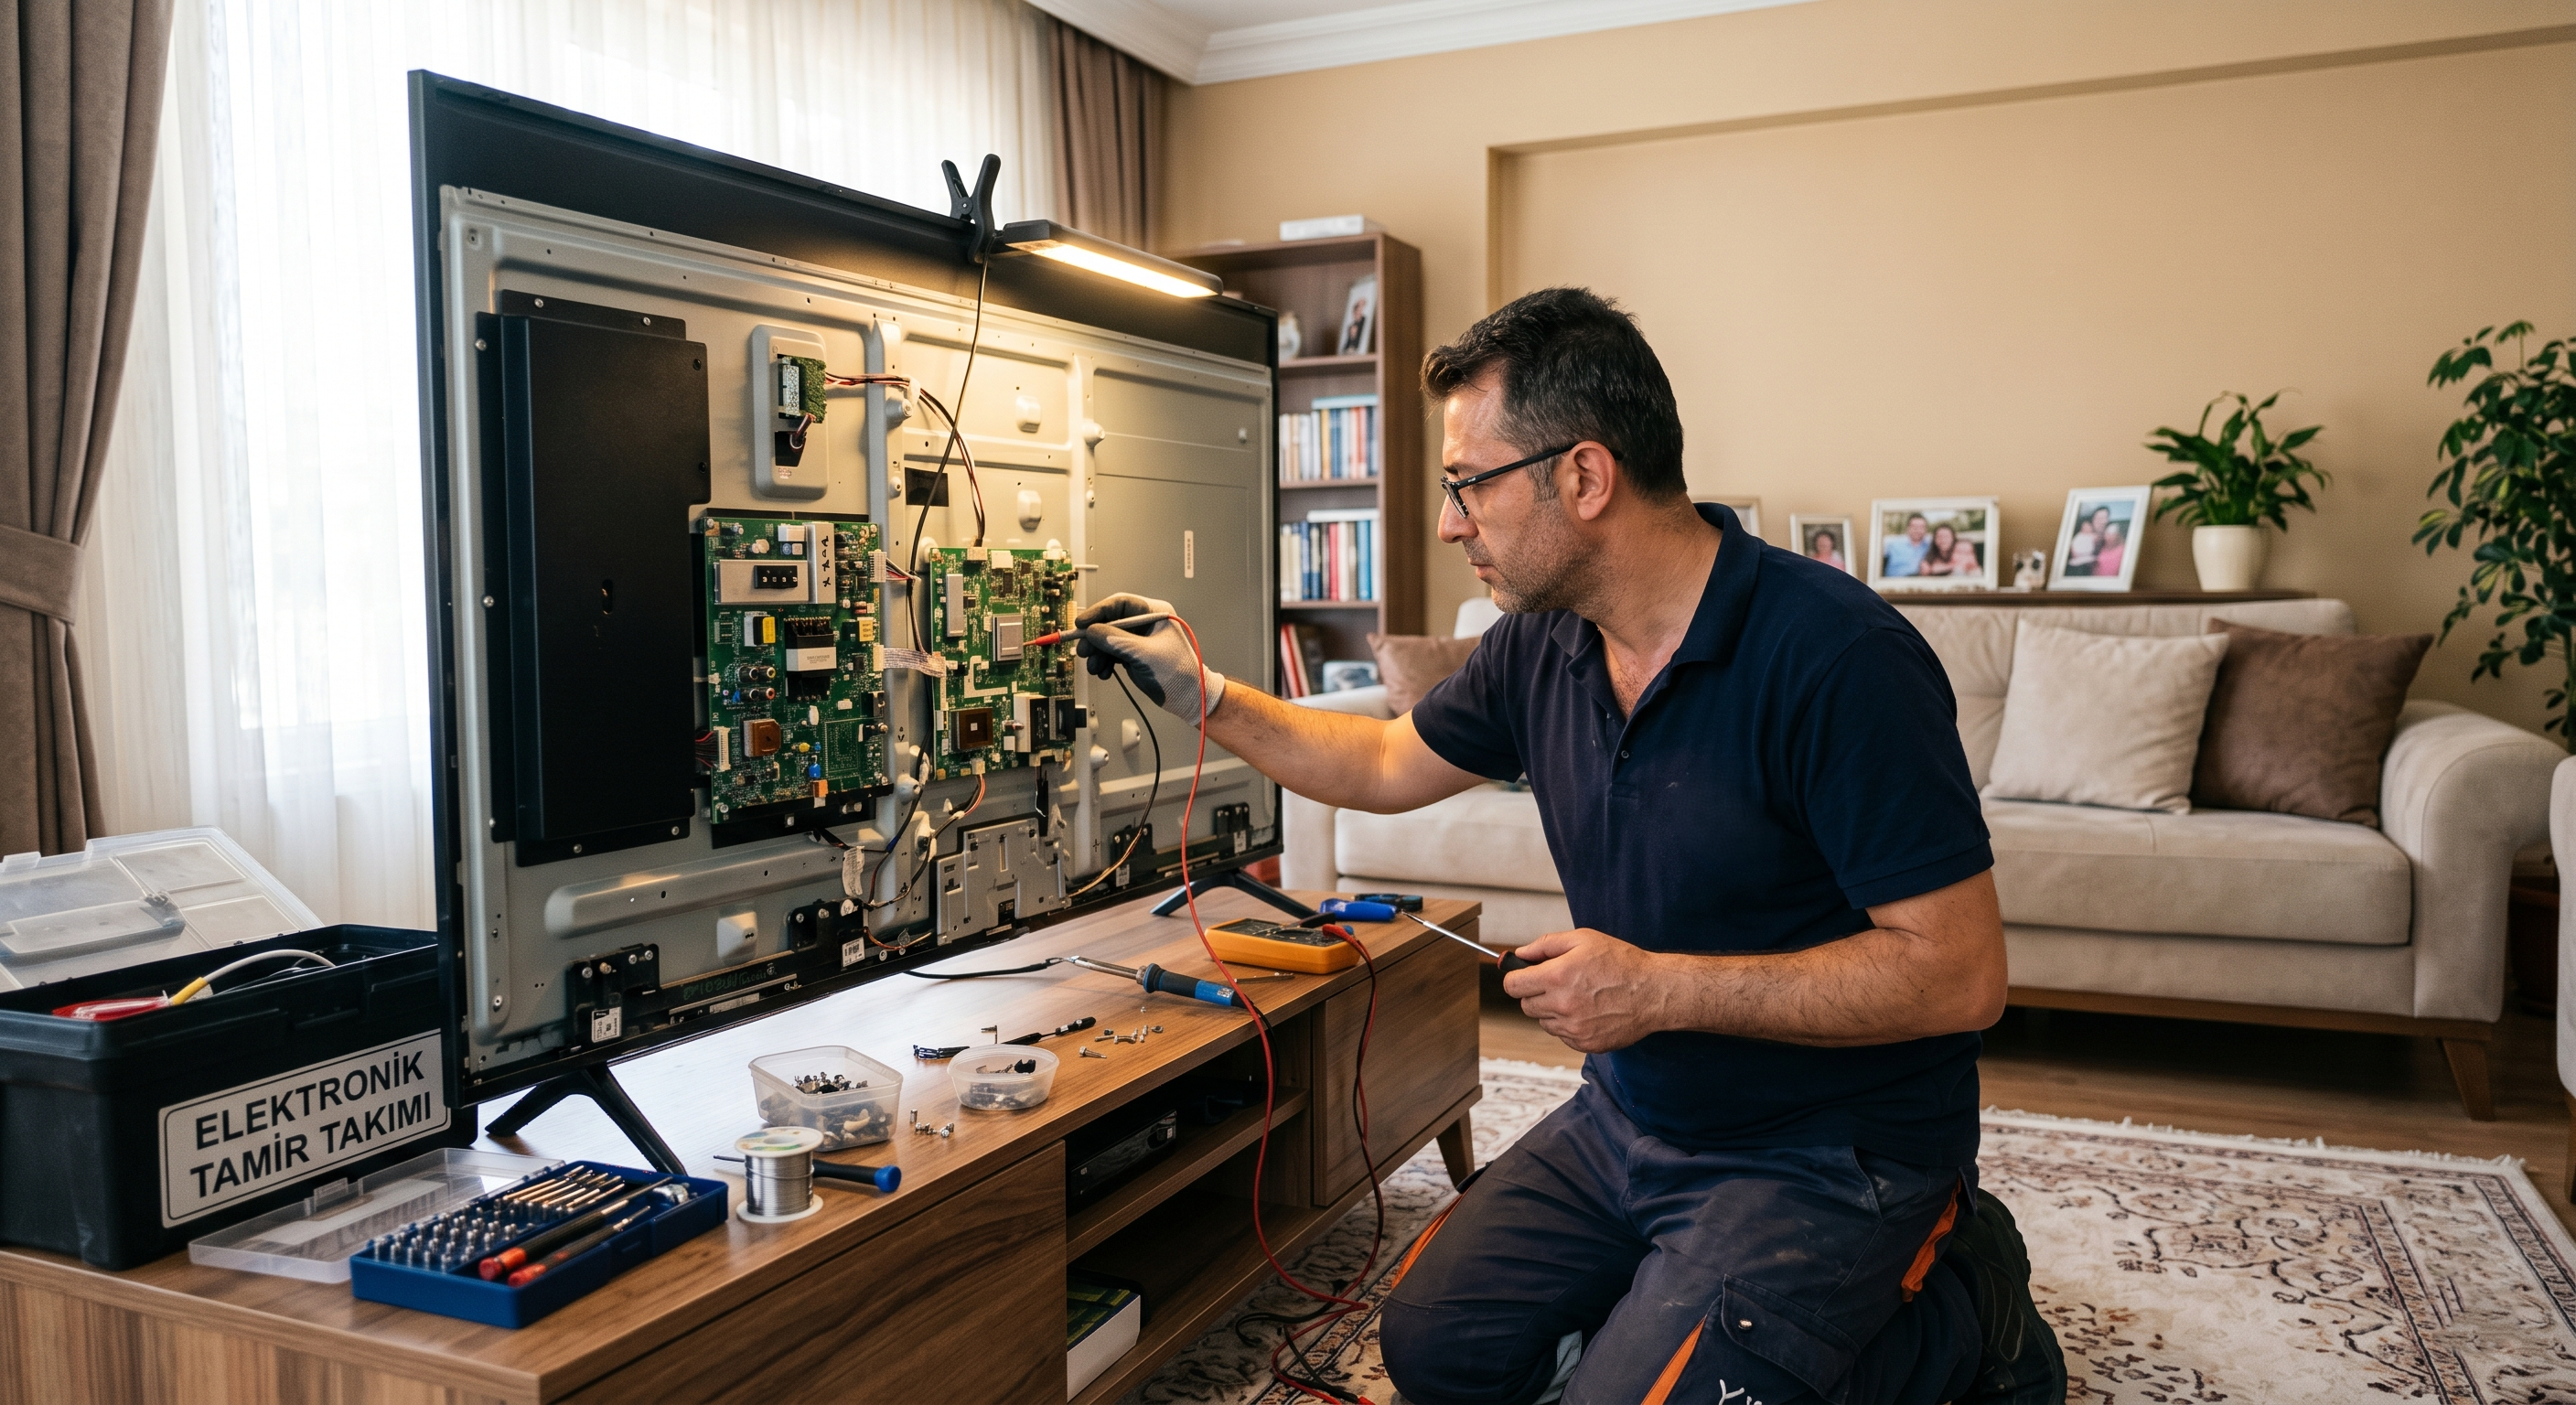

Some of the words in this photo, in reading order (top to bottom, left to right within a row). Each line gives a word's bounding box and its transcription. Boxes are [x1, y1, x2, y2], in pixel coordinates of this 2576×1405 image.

[189, 1132, 310, 1198] TAMİR
[319, 1090, 431, 1154] TAKIMI
[196, 1050, 424, 1151] ELEKTRONİK
